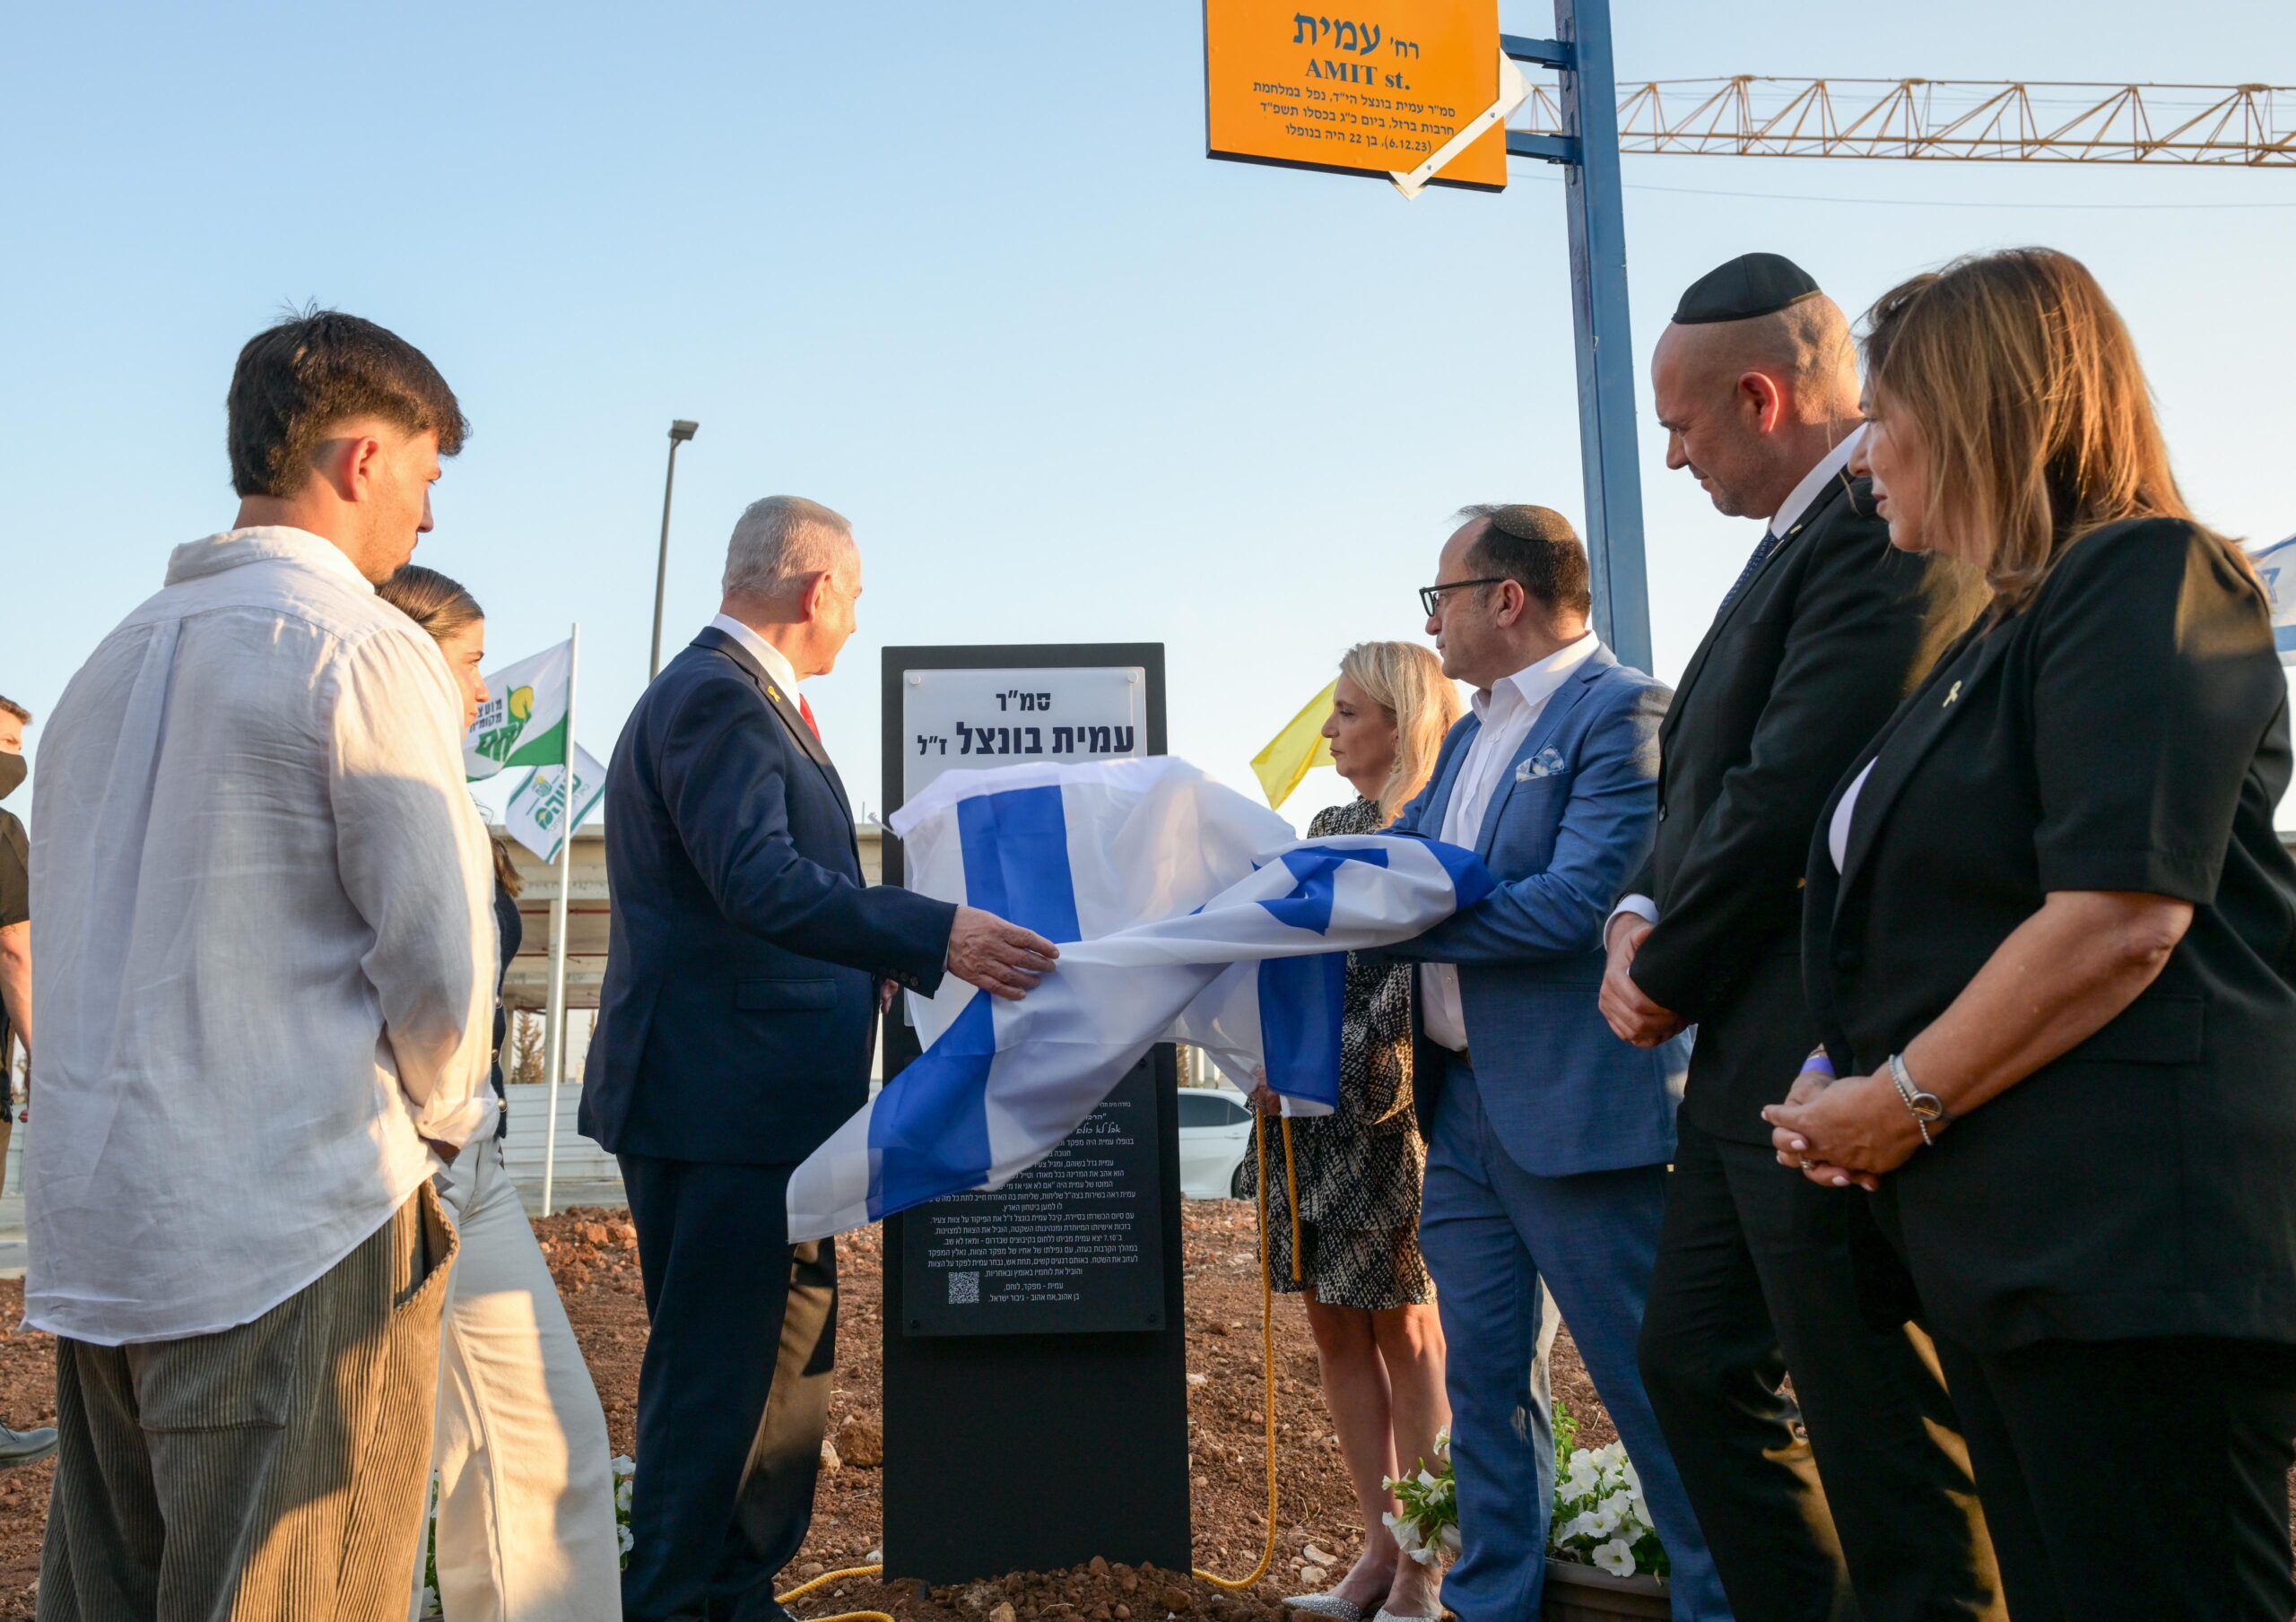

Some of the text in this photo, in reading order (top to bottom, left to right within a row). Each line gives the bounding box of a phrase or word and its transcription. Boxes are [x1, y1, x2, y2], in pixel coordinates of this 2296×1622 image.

[1292, 12, 1381, 56] עמית
[1305, 58, 1411, 91] AMIT st.
[1253, 81, 1301, 98] במלחמת
[1306, 87, 1326, 101] נפל
[1360, 95, 1393, 110] בונצל
[1396, 100, 1424, 114] עמית
[1303, 107, 1336, 122] בכסלו
[1361, 116, 1387, 128] ביום
[1285, 124, 1322, 140] בנופלו
[1325, 130, 1346, 142] היה
[1422, 124, 1455, 136] חרבות
[1348, 133, 1362, 143] 22
[1366, 134, 1378, 148] בן
[996, 690, 1051, 711] סמ"ר
[478, 698, 502, 717] מועצ
[917, 722, 1135, 756] עמית בונצל ז"ל
[1067, 1139, 1083, 1148] מפקד
[1033, 1181, 1042, 1189] לא
[1085, 1180, 1094, 1188] של
[1040, 1201, 1055, 1211] למען
[927, 1249, 951, 1257] המפקד
[988, 1247, 1006, 1256] מפקד
[1033, 1245, 1041, 1253] של
[945, 1258, 954, 1266] על
[1073, 1292, 1080, 1301] בן
